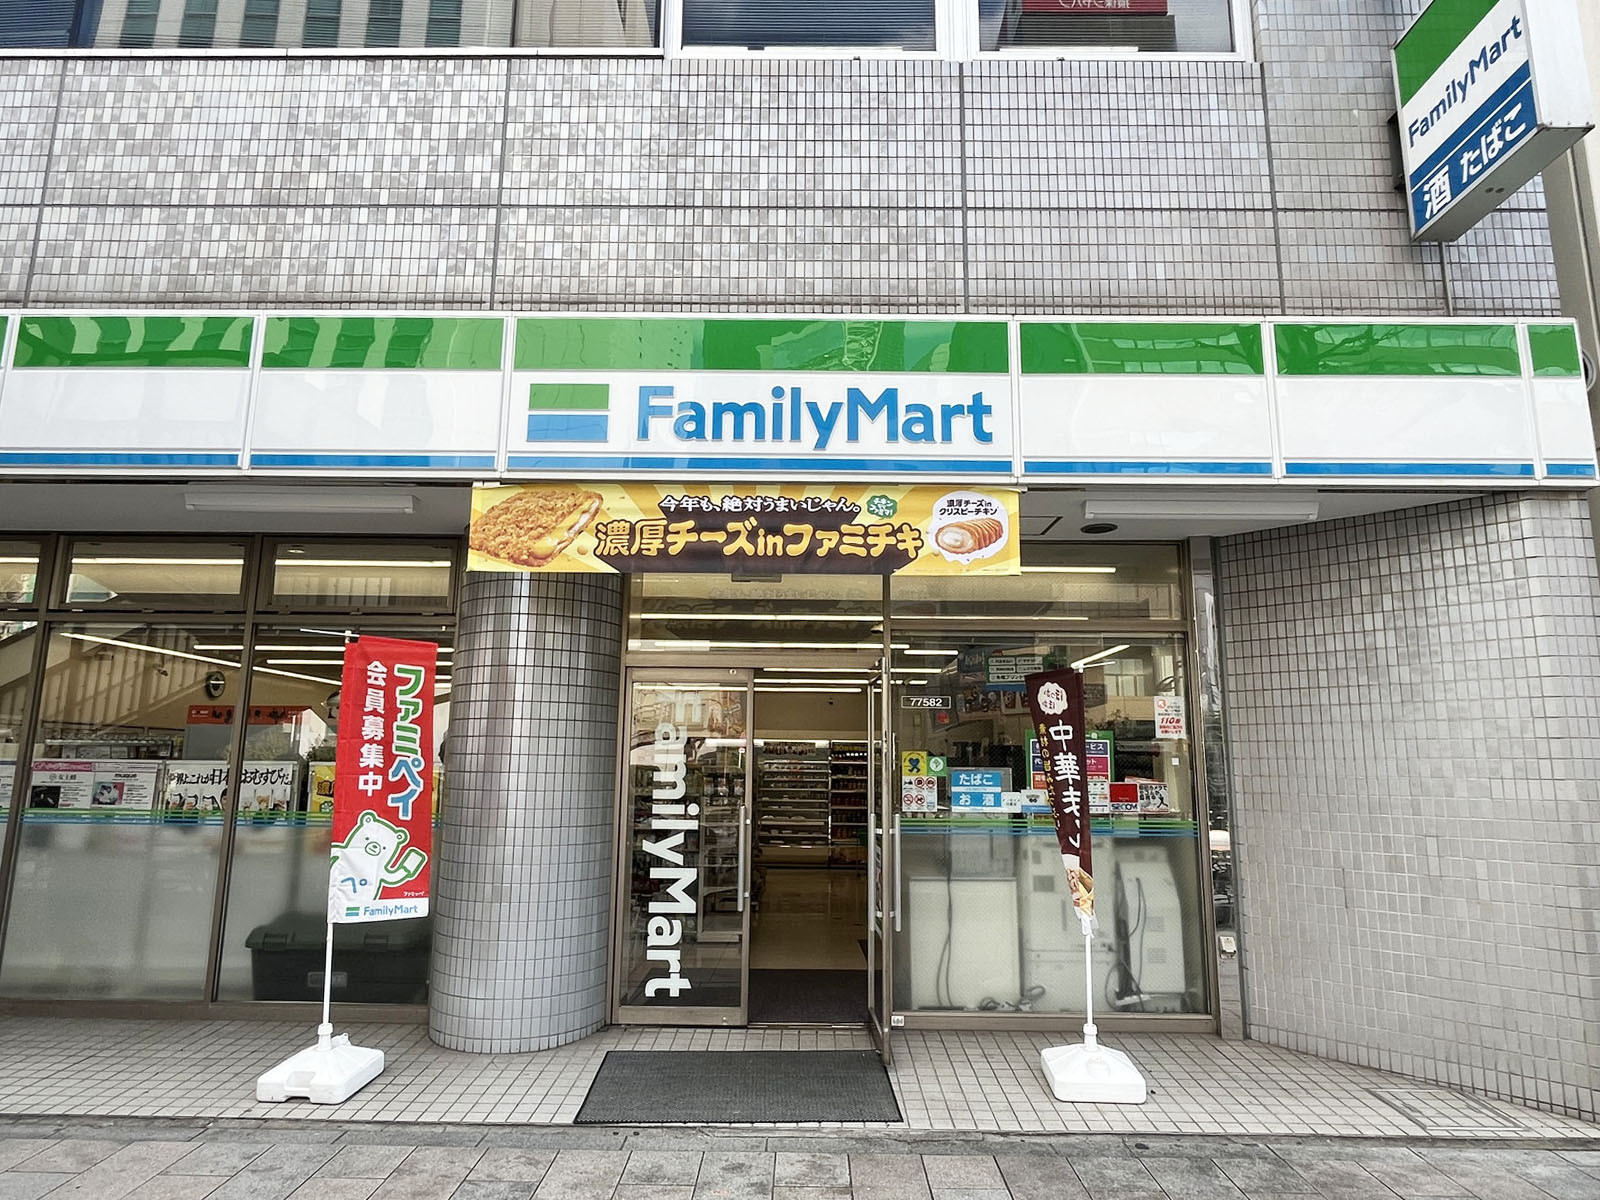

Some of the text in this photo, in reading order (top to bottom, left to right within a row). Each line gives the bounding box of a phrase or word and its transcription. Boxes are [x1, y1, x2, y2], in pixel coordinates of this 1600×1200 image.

[1408, 15, 1522, 148] FamilyMart
[1423, 102, 1526, 219] 酒 たばこ
[636, 385, 993, 451] FamilyMart
[660, 496, 861, 512] 今年も、絶対うまいじゃん。
[939, 508, 998, 516] クリスピーチキン
[596, 517, 922, 559] 濃厚チーズinファミチキ
[910, 697, 943, 707] 77582
[358, 660, 388, 796] 会員募集中
[390, 665, 423, 819] ファミペイ
[959, 774, 994, 786] たばこ
[341, 876, 368, 893] ペ
[363, 904, 418, 916] FamilyMart
